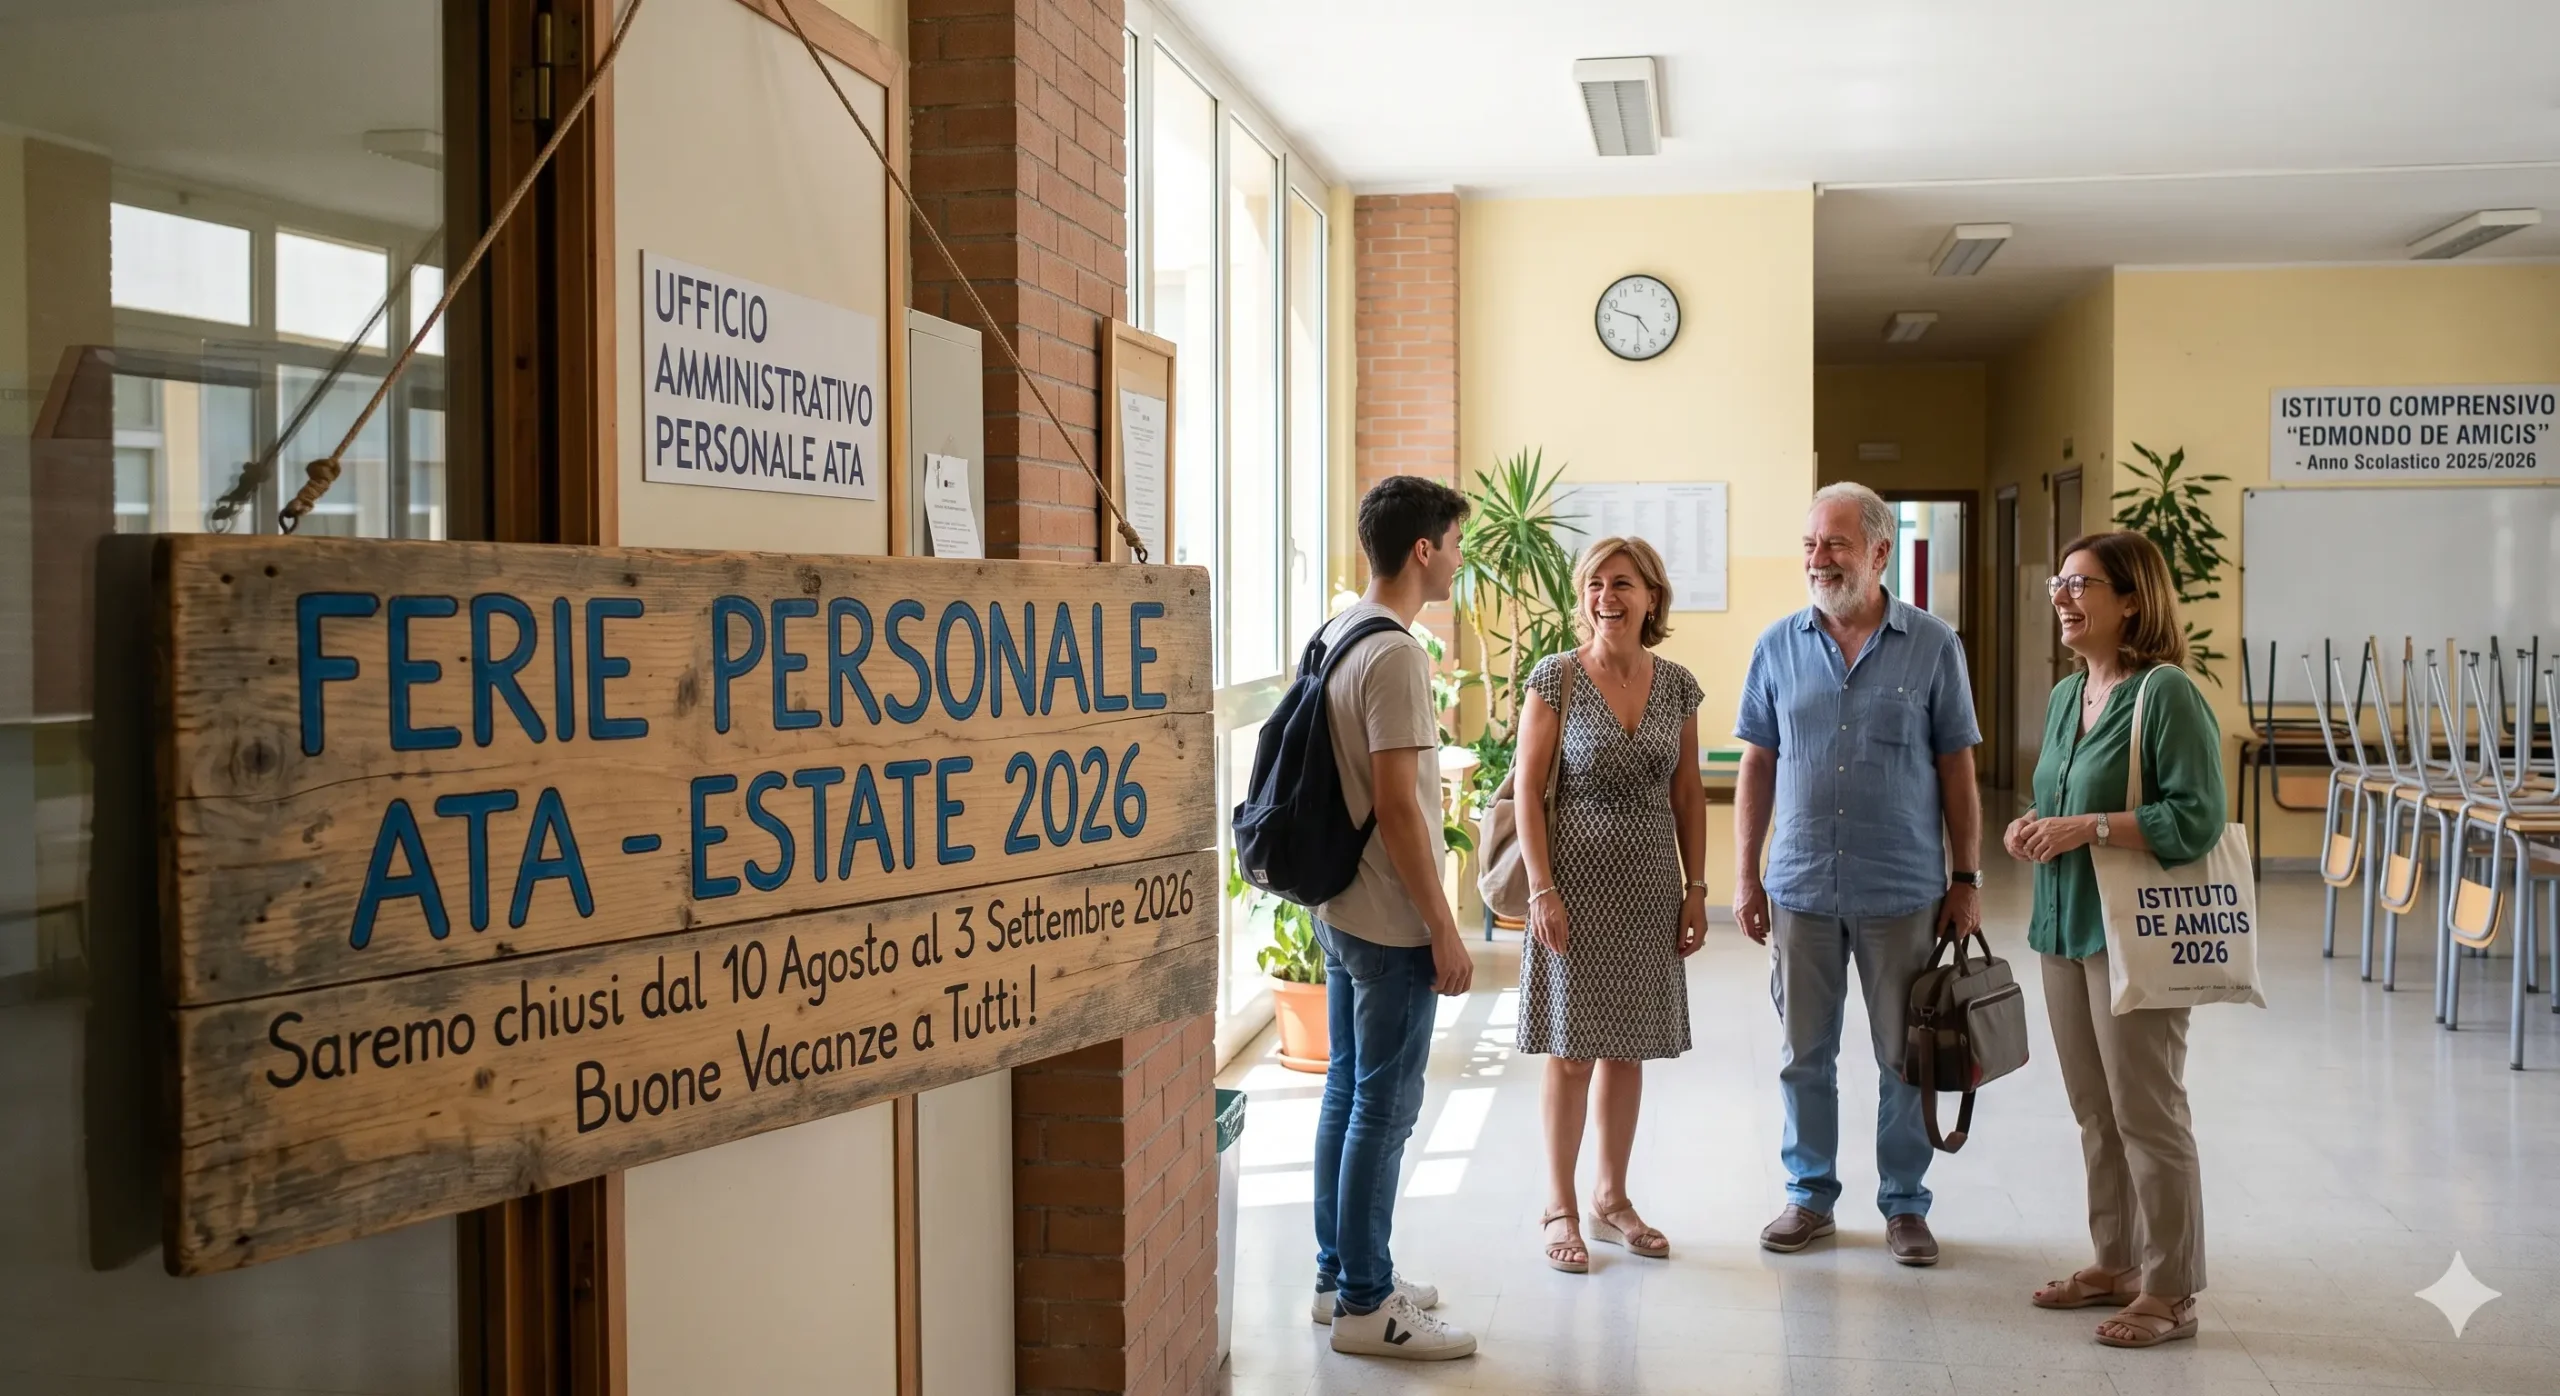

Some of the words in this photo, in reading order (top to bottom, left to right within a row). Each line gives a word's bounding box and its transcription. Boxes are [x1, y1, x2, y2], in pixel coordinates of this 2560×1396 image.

[1619, 288, 1627, 298] 11
[1633, 284, 1643, 293] 12
[1651, 288, 1655, 297] 1
[655, 269, 768, 344] UFFICIO
[1607, 299, 1618, 310] 10
[1660, 298, 1667, 308] 2
[1603, 313, 1611, 323] 9
[1663, 312, 1671, 323] 3
[1607, 329, 1615, 339] 8
[1660, 328, 1667, 337] 4
[1619, 338, 1626, 348] 7
[1633, 343, 1641, 353] 6
[1648, 338, 1657, 349] 5
[654, 342, 873, 427] AMMINISTRATIVO
[2281, 396, 2382, 418] ISTITUTO
[2389, 394, 2556, 416] COMPRENSIVO
[2420, 425, 2449, 445] DE
[656, 415, 817, 482] PERSONALE
[822, 439, 865, 486] ATA
[2306, 454, 2349, 470] Anno
[2354, 453, 2440, 469] Scolastico
[2446, 452, 2537, 470] 2025/2026
[296, 592, 650, 757] FERIE
[712, 594, 1168, 734] PERSONALE
[349, 786, 595, 950] ATA
[622, 833, 662, 854] -
[690, 755, 976, 900] ESTATE
[1004, 742, 1148, 856] 2026
[2137, 884, 2238, 909] ISTITUTO
[2136, 914, 2168, 937] DE
[2174, 911, 2250, 936] AMICIS
[2171, 940, 2229, 964] 2026
[266, 1012, 476, 1088] Saremo
[494, 974, 625, 1046] chiusi
[640, 950, 707, 1019] dal
[722, 940, 768, 1005] 10
[777, 922, 899, 1008] Agosto
[911, 913, 943, 968] al
[955, 906, 975, 960] 3
[986, 898, 1126, 953] Settembre
[1134, 869, 1194, 925] 2026
[575, 1060, 722, 1132] Buone
[736, 1023, 898, 1093] Vacanze
[912, 1011, 935, 1051] a
